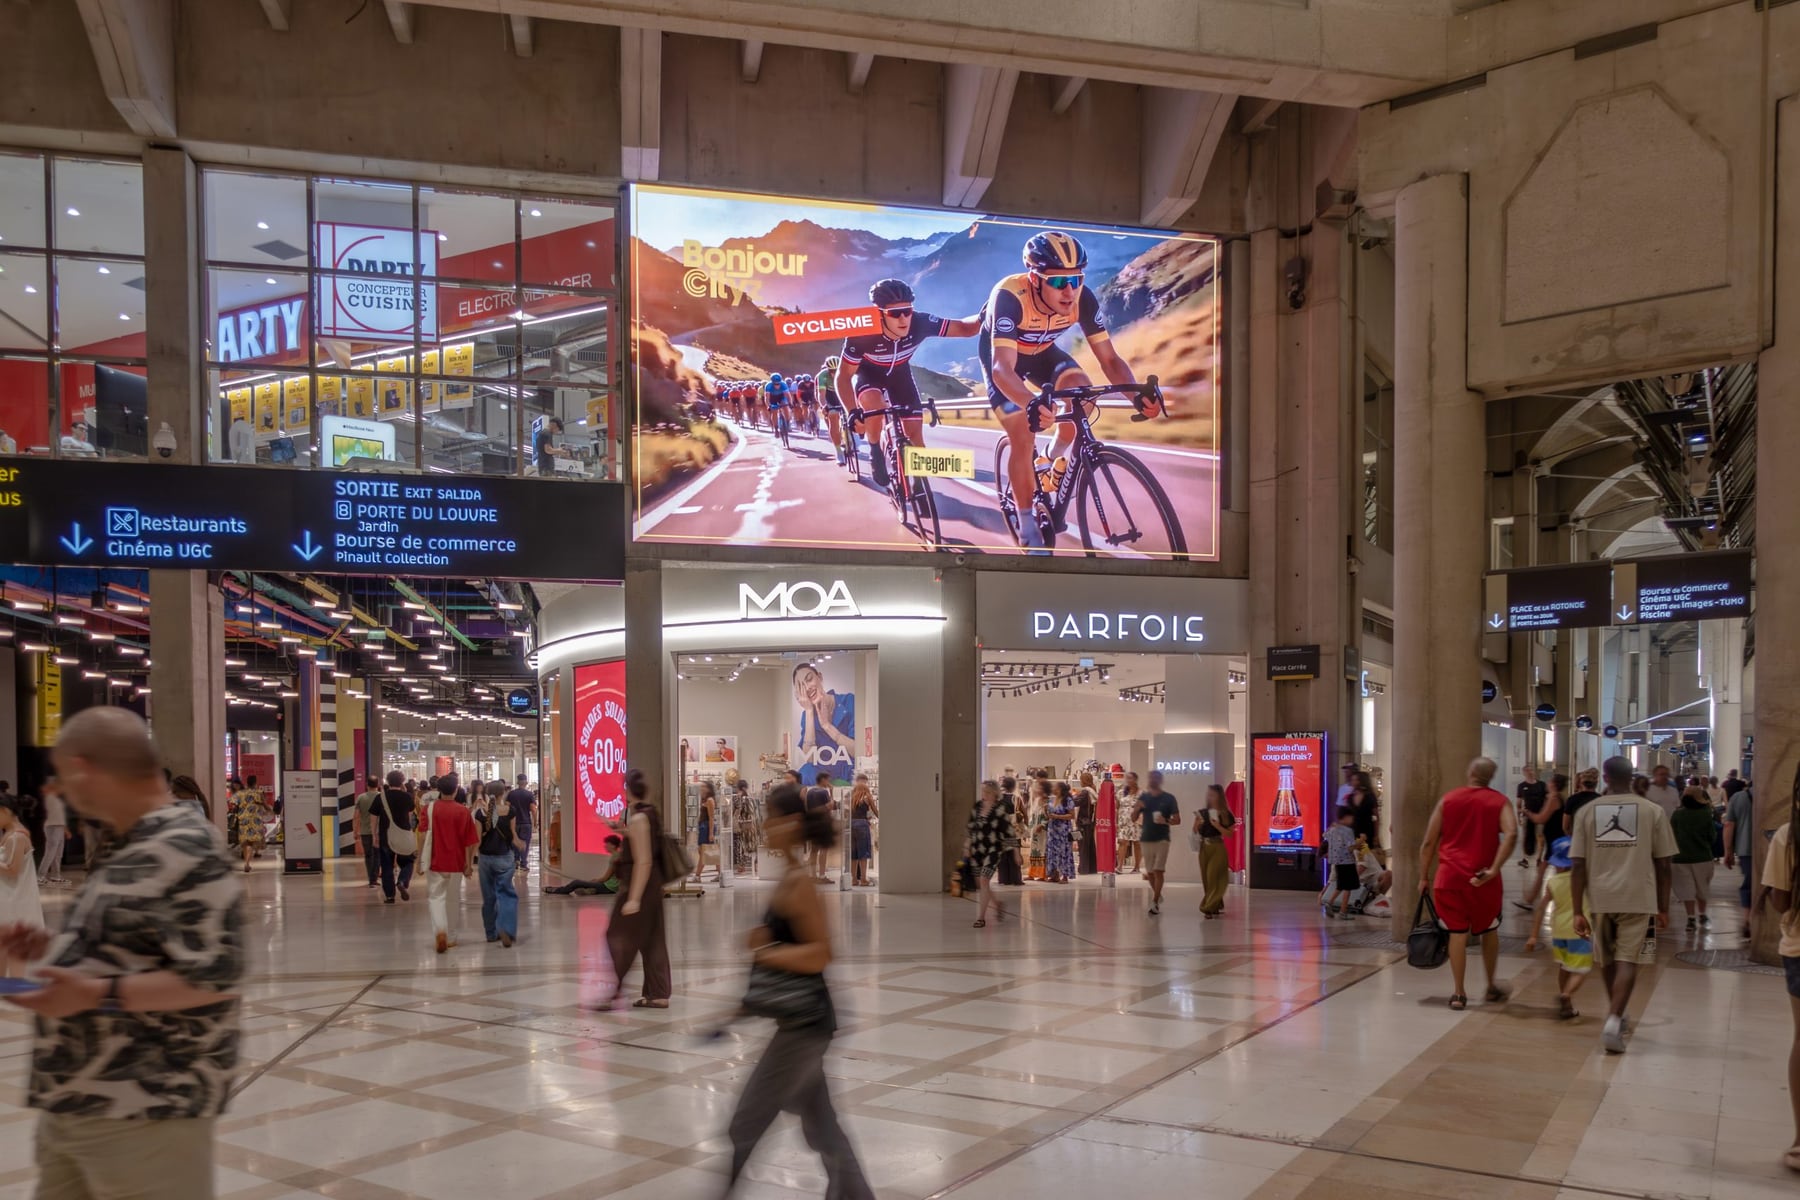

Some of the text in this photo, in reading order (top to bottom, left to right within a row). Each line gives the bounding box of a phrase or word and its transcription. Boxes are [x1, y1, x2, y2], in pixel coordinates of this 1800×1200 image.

[683, 239, 808, 278] Bonjour
[783, 314, 874, 336] CYCLISME
[911, 452, 961, 474] Gregario
[336, 481, 482, 501] SORTIE EXIT SALIDA
[338, 502, 498, 522] 8 PORTE DU LOUVRE
[140, 516, 247, 534] Restaurants
[358, 521, 399, 533] Jardin
[108, 540, 213, 559] Cinéma UGC
[336, 534, 516, 552] Bourse de commerce
[336, 551, 449, 565] Pinault Collection
[1640, 587, 1671, 596] Bourse
[1681, 583, 1729, 593] Commerce
[739, 580, 862, 618] MOA
[1551, 601, 1585, 610] ROTONDE
[1640, 595, 1671, 603] Cinéma
[1640, 603, 1668, 611] Forum
[1681, 600, 1713, 609] Images
[1720, 598, 1744, 606] TUMO
[1640, 611, 1671, 619] Piscine
[1033, 612, 1204, 642] PARFOIS
[580, 704, 601, 748] SOLDES
[796, 745, 853, 766] MOA
[1266, 743, 1307, 752] Besoin d'un
[1157, 761, 1211, 771] PARFOIS
[579, 754, 596, 805] SOLDES
